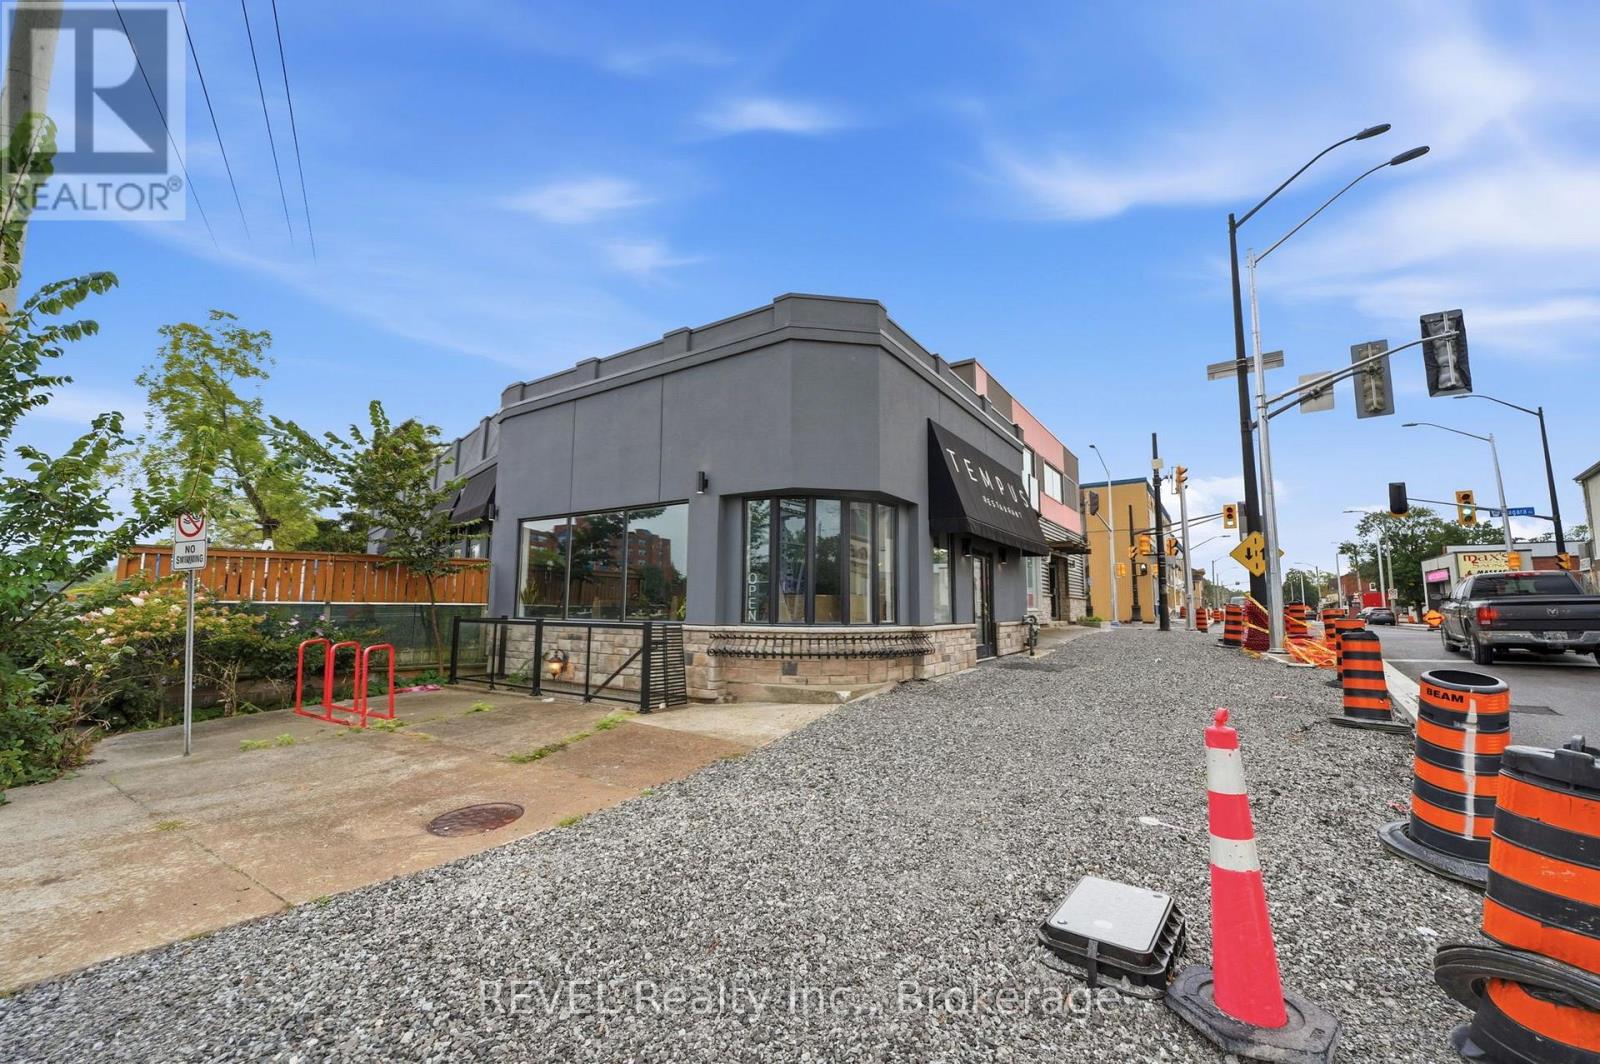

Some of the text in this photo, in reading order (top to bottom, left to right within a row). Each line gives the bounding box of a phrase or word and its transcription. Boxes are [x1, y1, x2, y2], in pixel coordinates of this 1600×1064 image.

[946, 448, 1029, 508] TEMPUS
[184, 544, 196, 554] NO
[176, 554, 204, 564] SWIMMING
[748, 572, 758, 622] OPEN
[1426, 687, 1465, 703] BEAM
